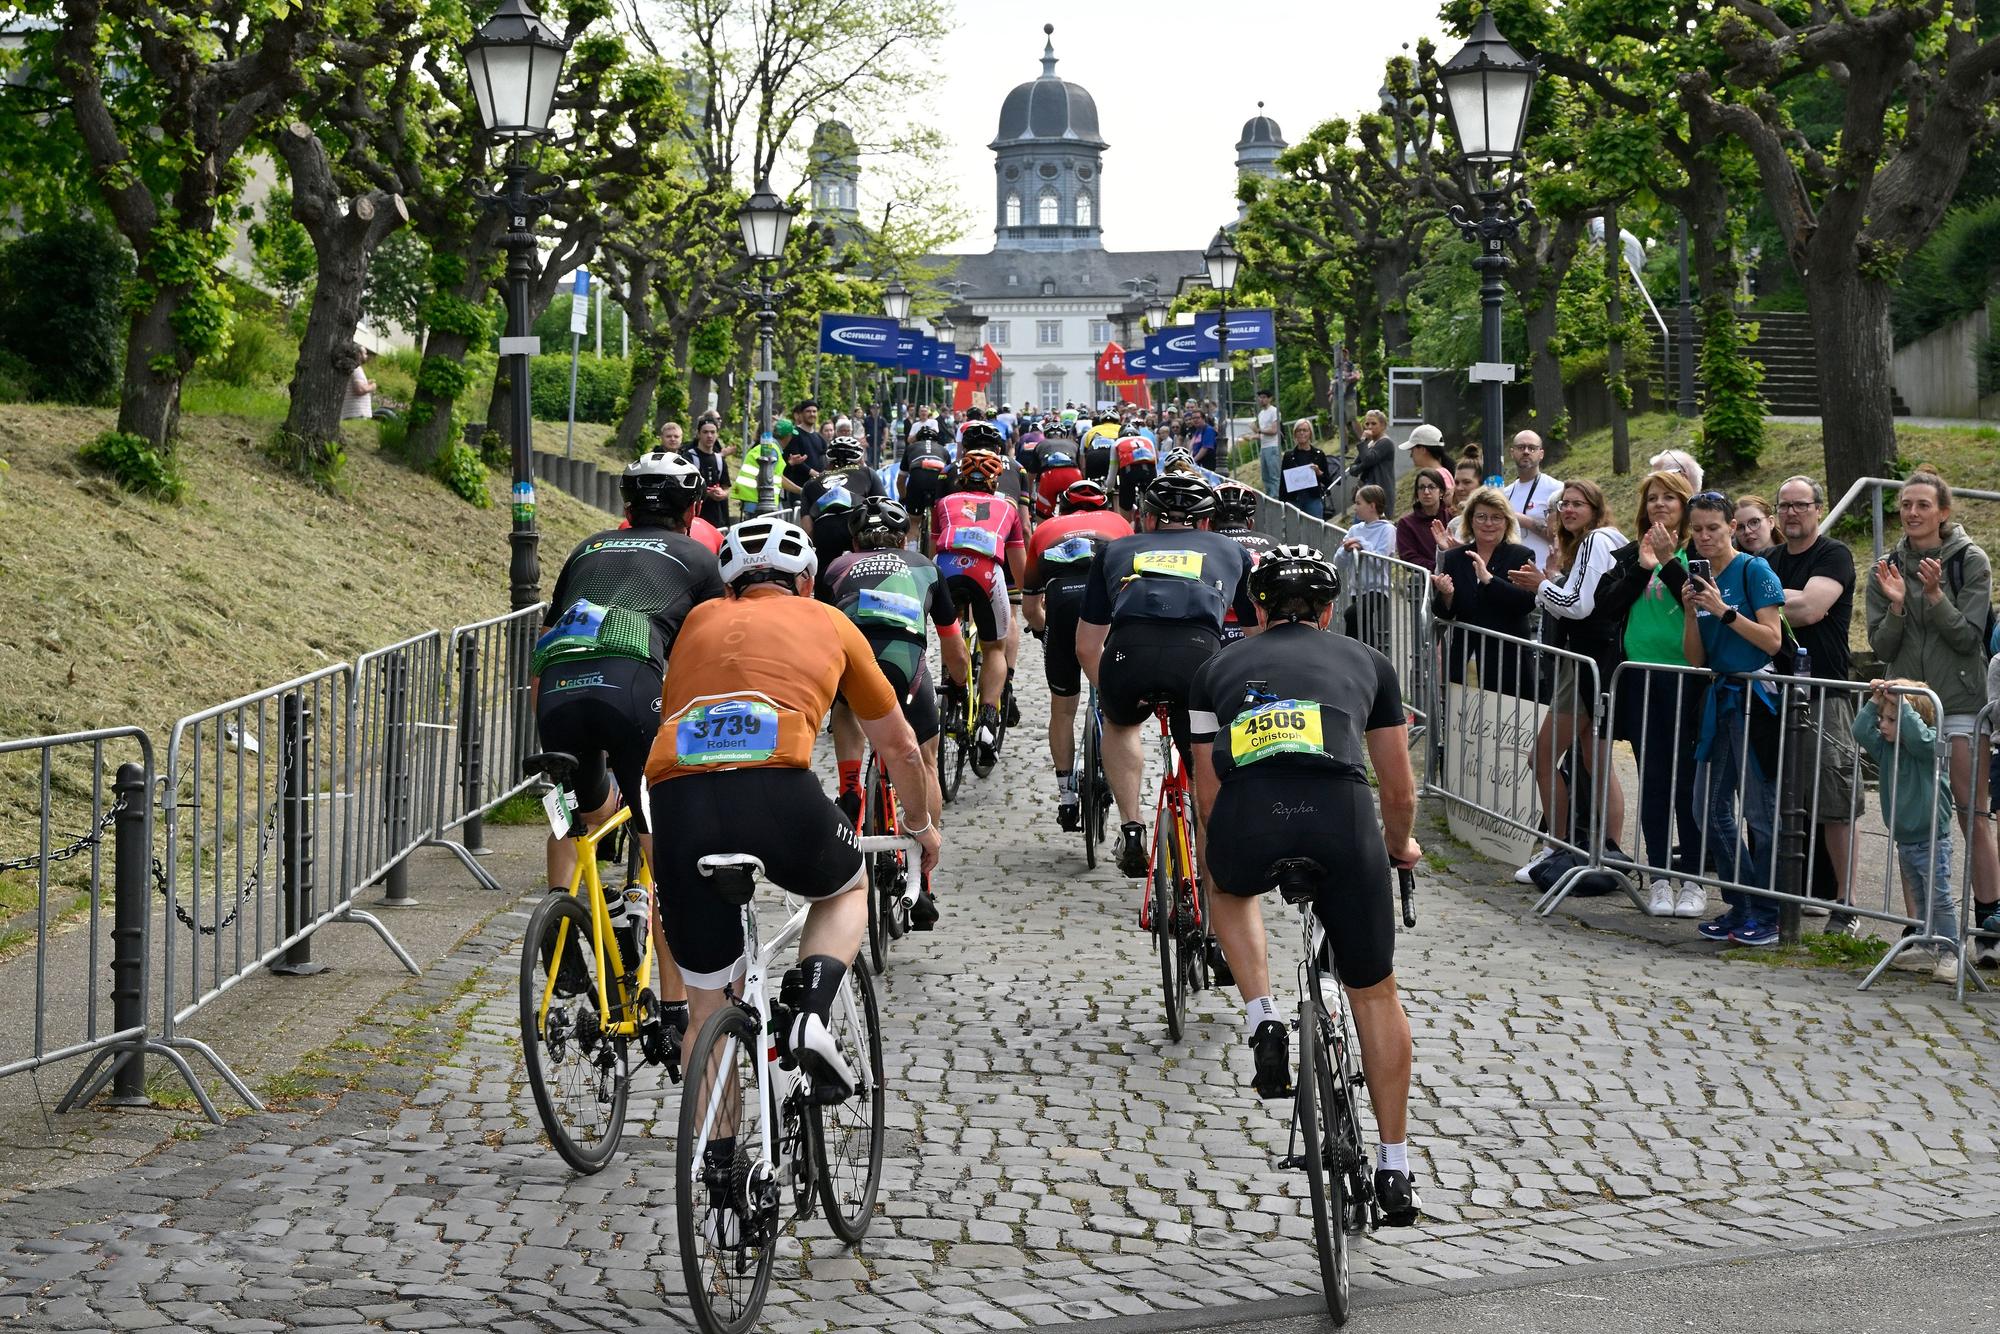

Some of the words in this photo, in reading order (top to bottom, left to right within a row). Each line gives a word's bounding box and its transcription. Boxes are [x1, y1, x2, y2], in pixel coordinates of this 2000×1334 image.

[840, 331, 887, 342] SCHWALBE
[961, 531, 990, 546] 1363
[584, 540, 669, 554] LOGISTICS
[743, 555, 767, 565] KASK
[852, 561, 909, 570] ESCHBORN
[1144, 554, 1189, 566] 2231
[849, 565, 913, 576] FRANKFURT
[1279, 568, 1315, 576] OAKLEY
[1227, 631, 1245, 639] Gra
[555, 675, 604, 690] LOGISTICS
[693, 713, 761, 740] 3739
[1244, 711, 1306, 736] 4506
[706, 739, 747, 750] Robert
[1251, 731, 1302, 748] Christoph
[1256, 742, 1300, 757] #rundumkoeln
[701, 752, 752, 762] #rundumkoeln
